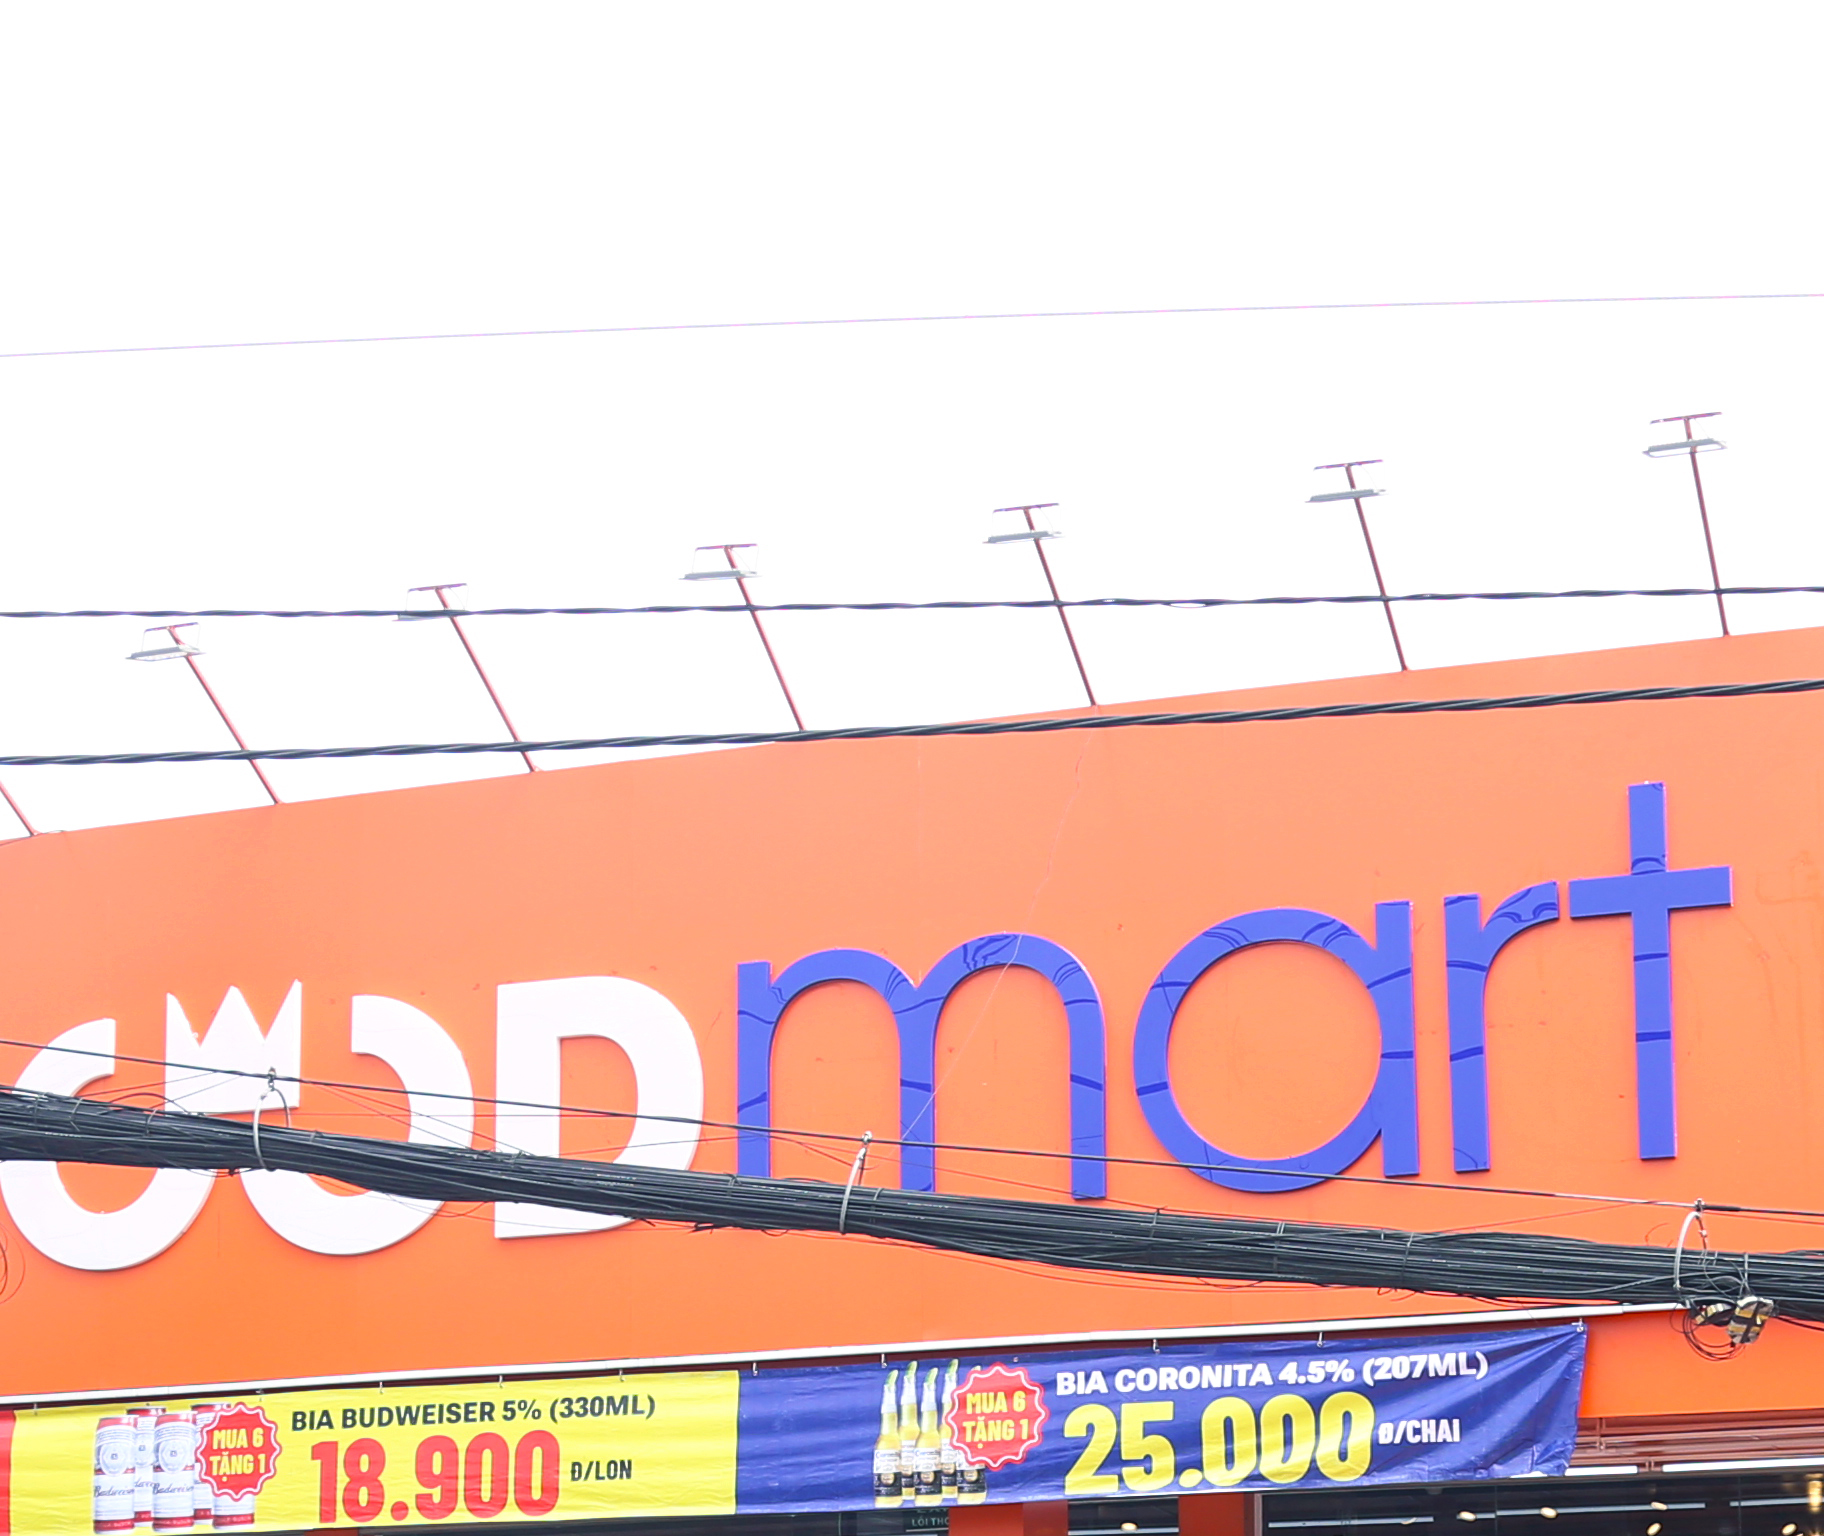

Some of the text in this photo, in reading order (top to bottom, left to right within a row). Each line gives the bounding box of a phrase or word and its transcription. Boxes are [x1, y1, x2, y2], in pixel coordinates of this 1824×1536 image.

[1056, 1352, 1489, 1397] BIA CORONITA 4.5% (207ML)
[291, 1394, 657, 1432] BIA BUDWEISER 5% (330ML)
[966, 1390, 1026, 1415] MUA 6
[212, 1427, 264, 1450] MUA 6
[962, 1416, 1029, 1449] TẶNG 1
[1064, 1391, 1376, 1497] 25.000
[209, 1451, 265, 1482] TẶNG 1
[311, 1430, 633, 1524] 18.900 Đ/LON
